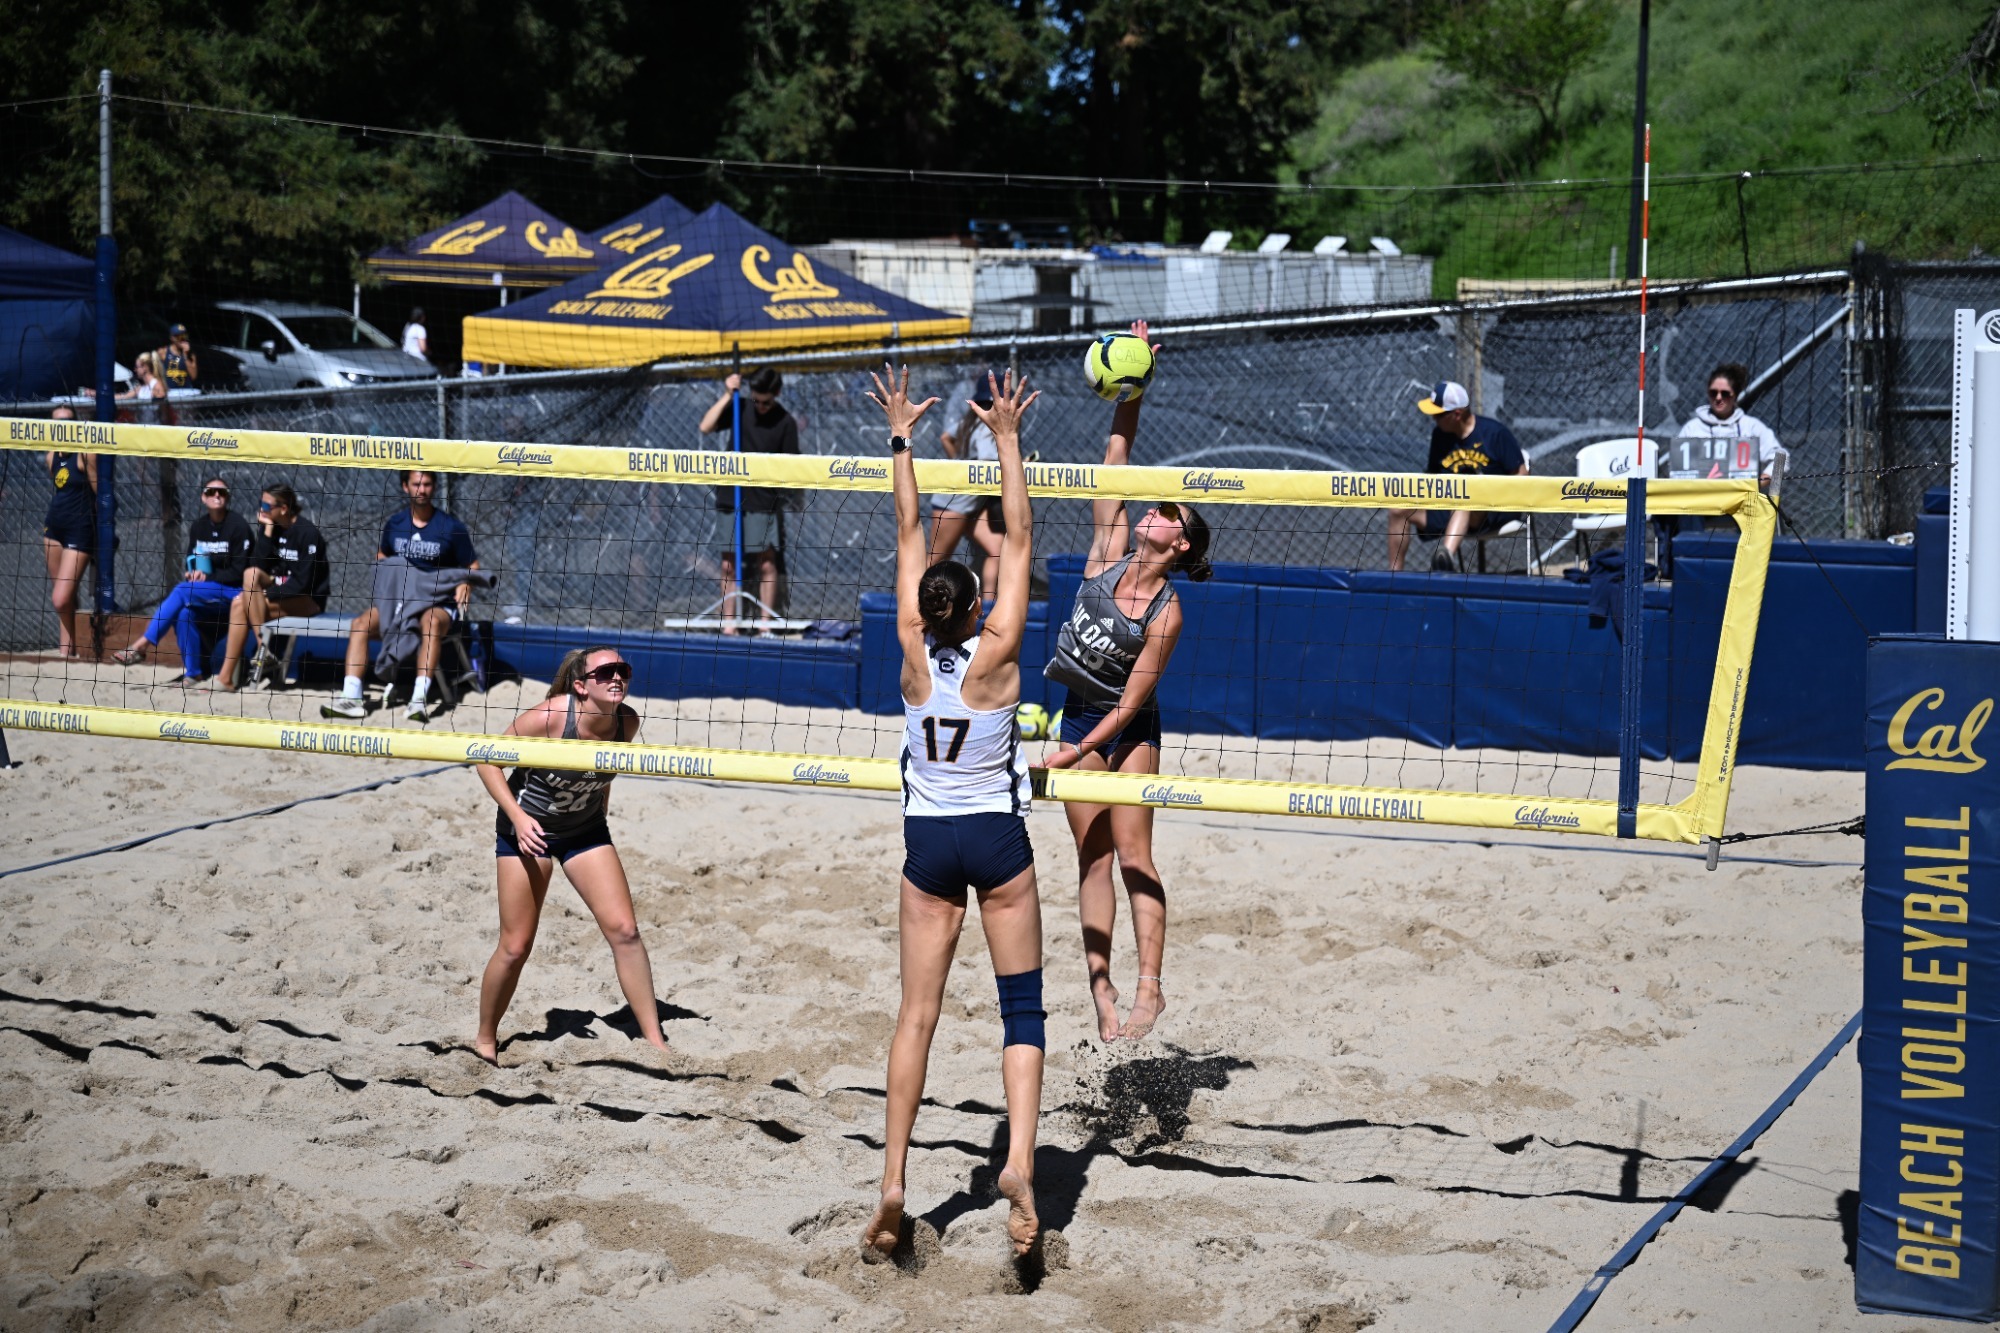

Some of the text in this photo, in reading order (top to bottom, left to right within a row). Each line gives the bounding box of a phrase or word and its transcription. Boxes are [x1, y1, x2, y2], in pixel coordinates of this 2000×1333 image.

[418, 220, 507, 256] Cal
[525, 220, 595, 258] Cal
[585, 244, 715, 299] Cal
[741, 245, 840, 302] Cal
[1114, 348, 1141, 362] CAL
[10, 421, 117, 445] BEACH VOLLEYBALL
[186, 430, 239, 450] California
[310, 437, 424, 461] BEACH VOLLEYBALL
[497, 445, 553, 466] California
[1680, 441, 1690, 470] 1
[1737, 441, 1750, 469] 0
[628, 452, 749, 476] BEACH VOLLEYBALL
[828, 458, 888, 480] California
[1609, 455, 1631, 476] Cal
[968, 464, 1098, 489] BEAC OLLEYBALL
[1182, 470, 1246, 492] California
[1331, 475, 1471, 500] BEACH VOLLEYBALL
[1561, 481, 1628, 503] California
[1073, 603, 1091, 633] UC
[938, 658, 955, 674] C
[0, 708, 91, 733] ACH VOLLEYBALL
[158, 720, 211, 741] California
[1884, 687, 1994, 774] Cal
[280, 729, 393, 756] BEACH VOLLEYBALL
[922, 715, 971, 764] 17
[465, 742, 520, 764] California
[595, 750, 715, 777] BEACH VOLLEYBALL
[545, 773, 611, 793] UC DAV
[792, 762, 851, 784] California
[1140, 783, 1204, 807] California
[1288, 793, 1425, 820] BEACH VOLLEYBALL
[1513, 805, 1581, 828] California
[1895, 806, 1970, 1280] BEACH VOLLEYBALL
